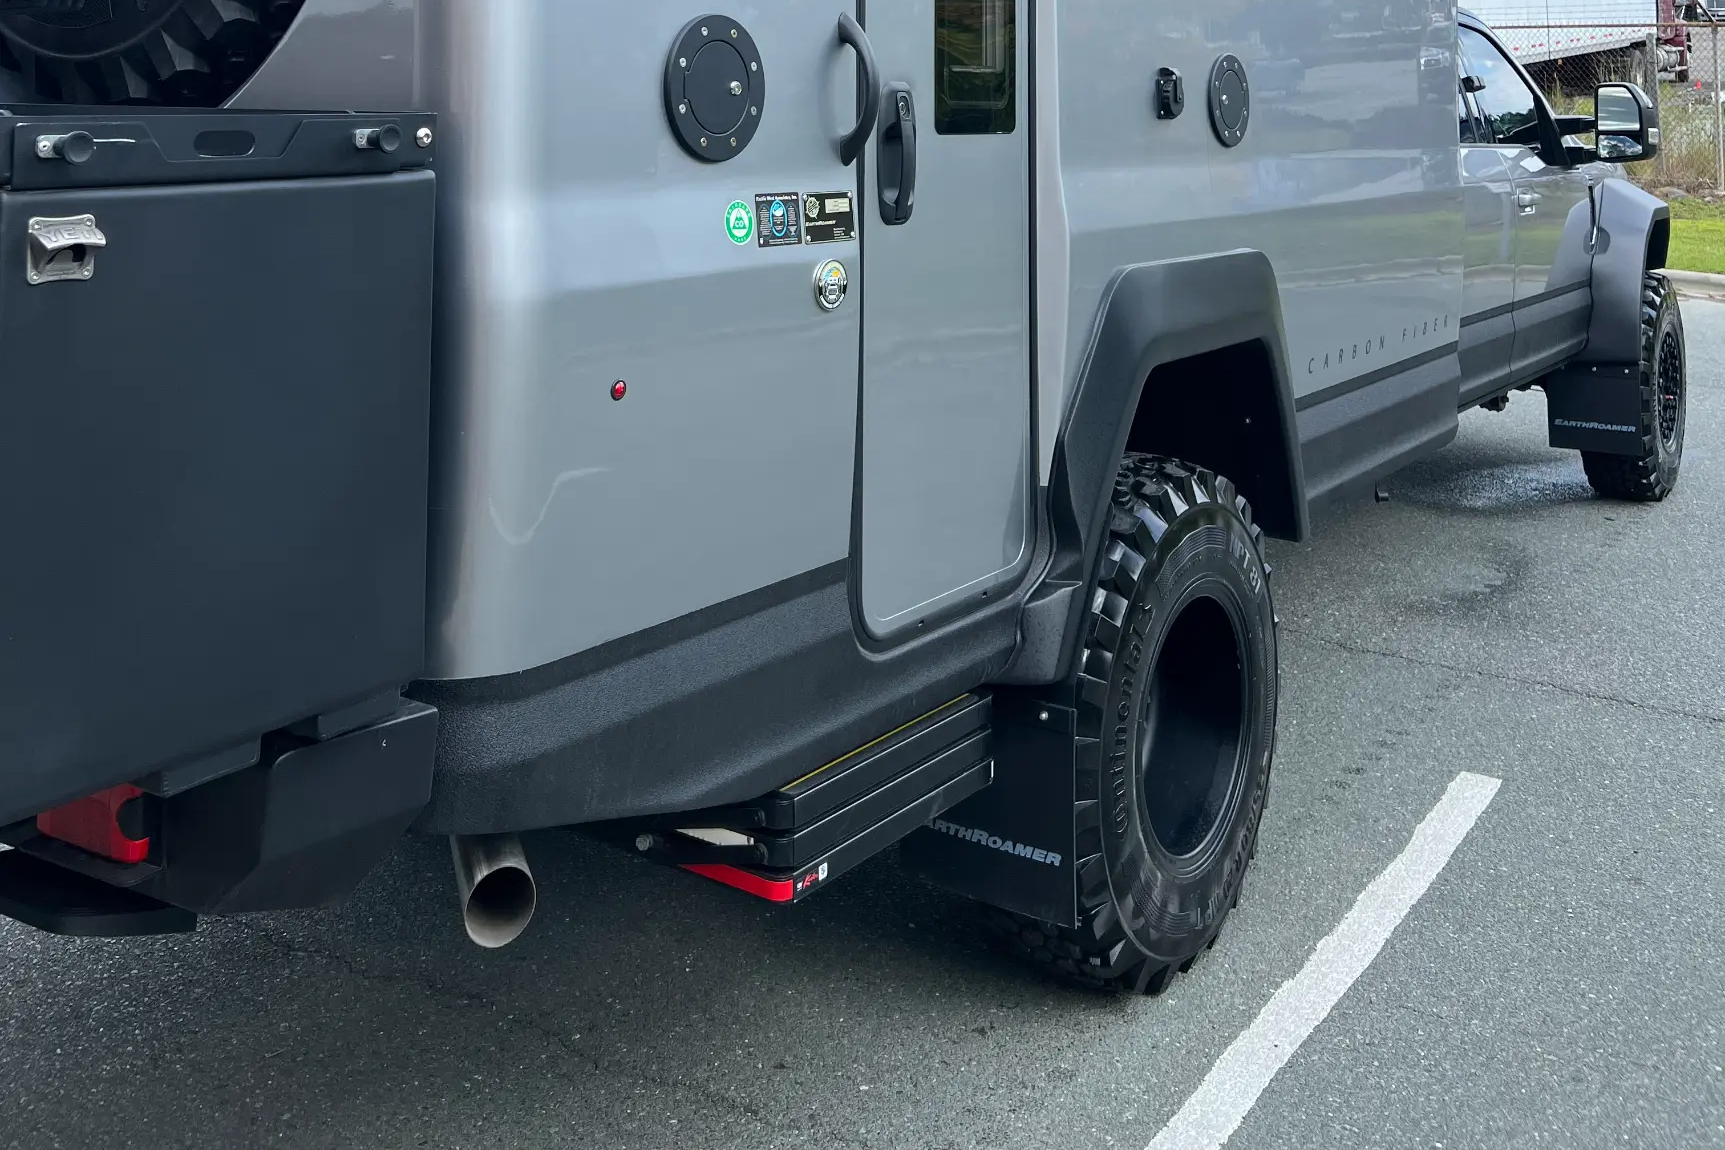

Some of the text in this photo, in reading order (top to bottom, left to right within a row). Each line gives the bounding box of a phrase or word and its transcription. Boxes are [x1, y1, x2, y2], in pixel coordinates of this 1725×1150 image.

[38, 227, 104, 243] YETI
[735, 220, 744, 228] CO
[1307, 314, 1448, 374] CARBON FIBER
[1108, 607, 1156, 838] Continental
